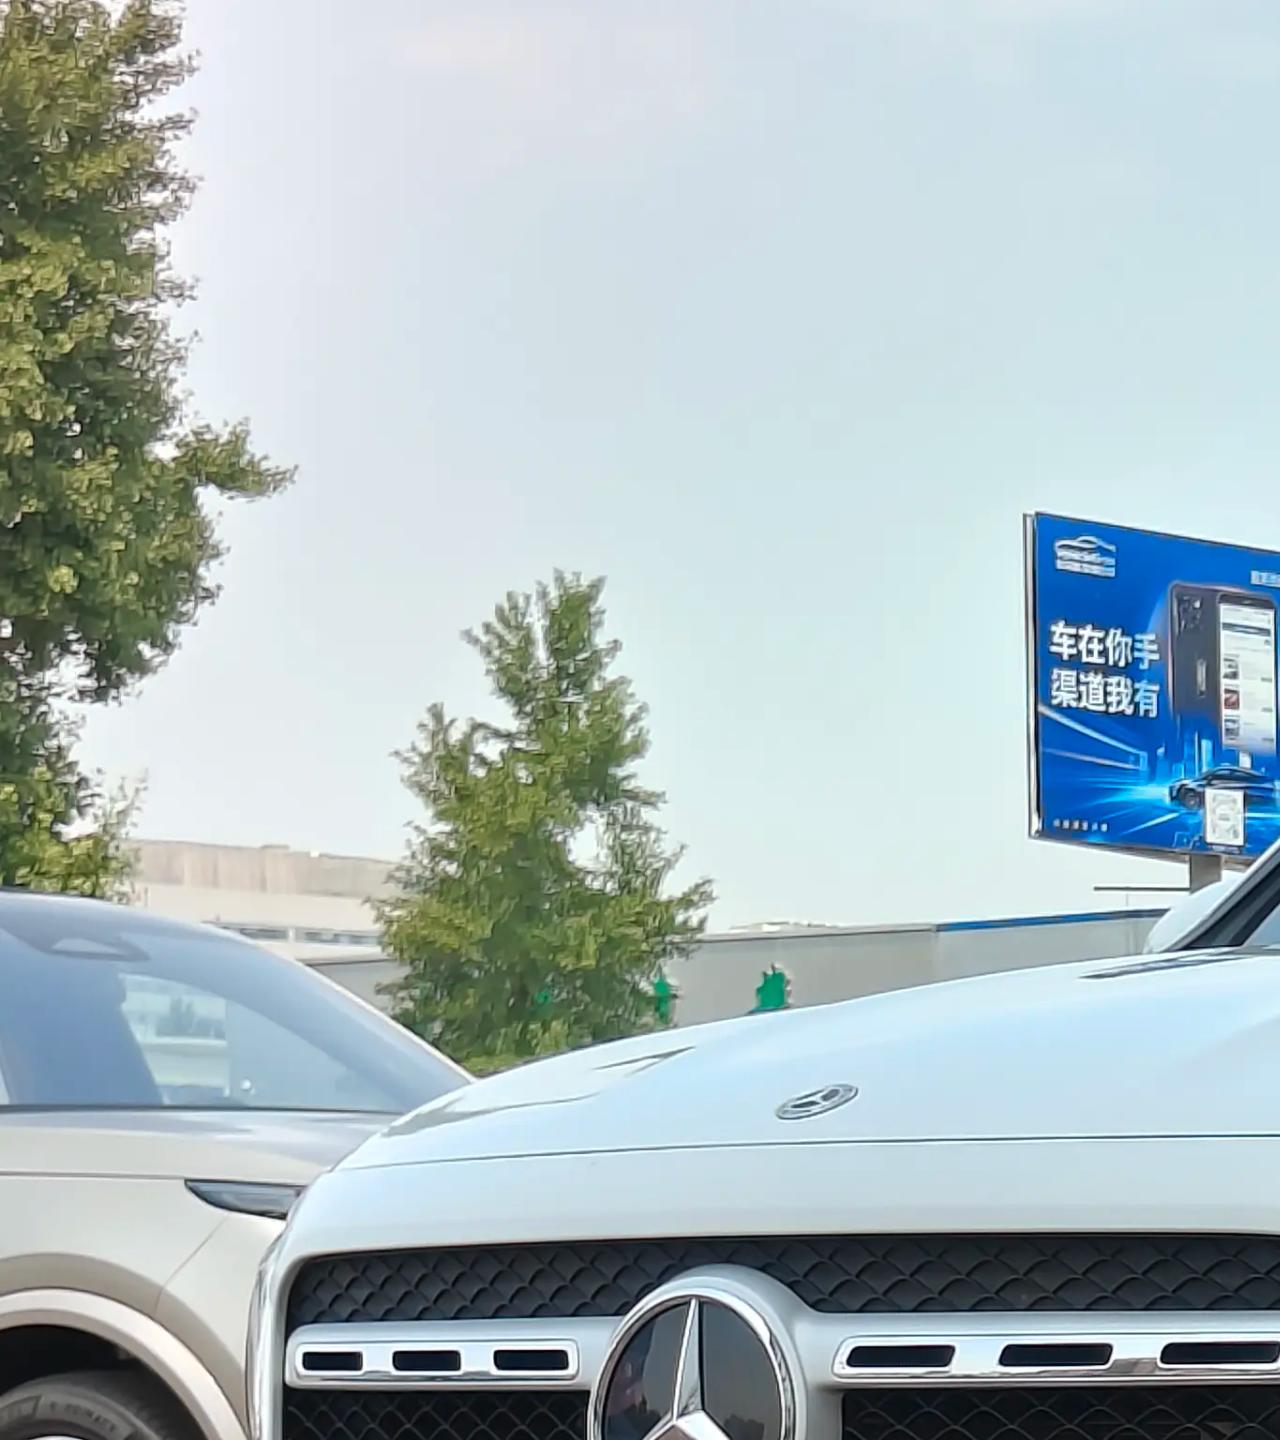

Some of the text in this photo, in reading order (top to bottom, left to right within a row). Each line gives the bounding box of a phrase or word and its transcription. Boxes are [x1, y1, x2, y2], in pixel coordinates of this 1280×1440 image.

[1049, 620, 1160, 670] 车在你手
[1050, 669, 1160, 718] 渠道我有
